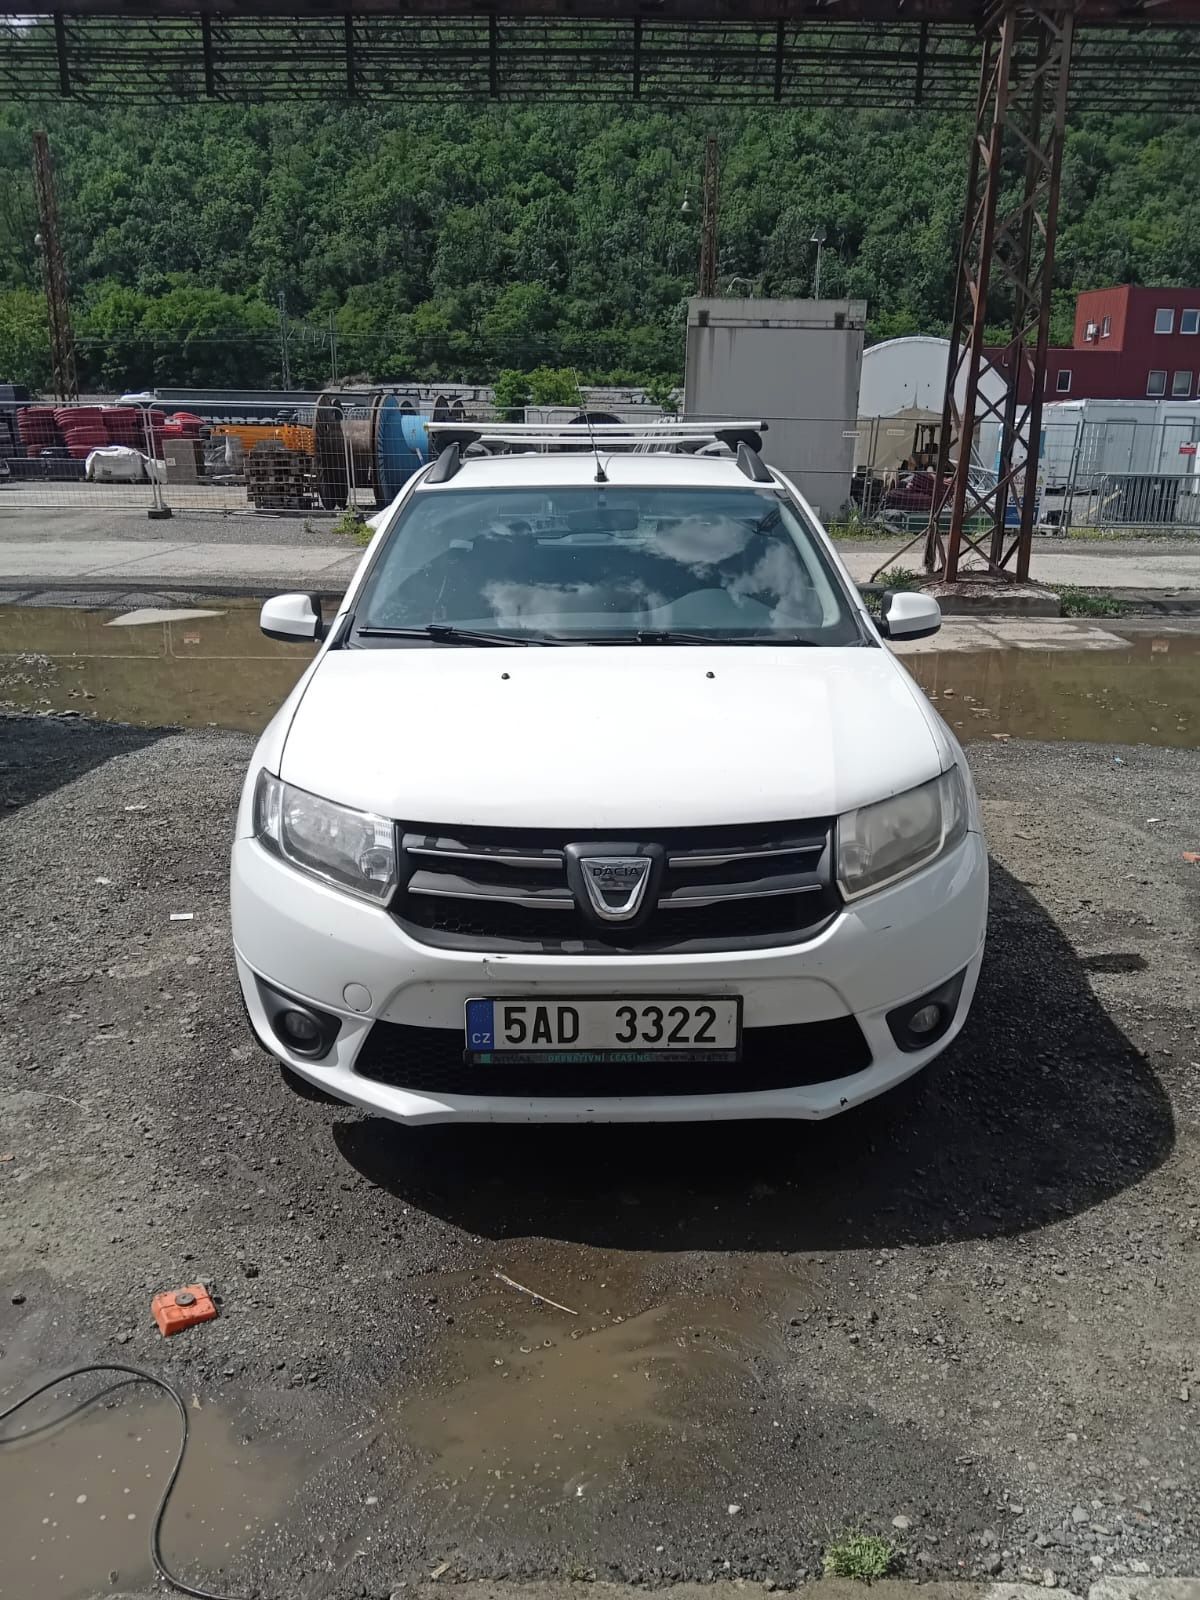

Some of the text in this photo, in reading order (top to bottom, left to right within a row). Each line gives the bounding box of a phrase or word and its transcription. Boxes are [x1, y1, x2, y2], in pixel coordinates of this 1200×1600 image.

[592, 867, 639, 877] DACIA
[503, 1005, 717, 1044] 5AD 3322
[472, 1032, 491, 1044] CZ
